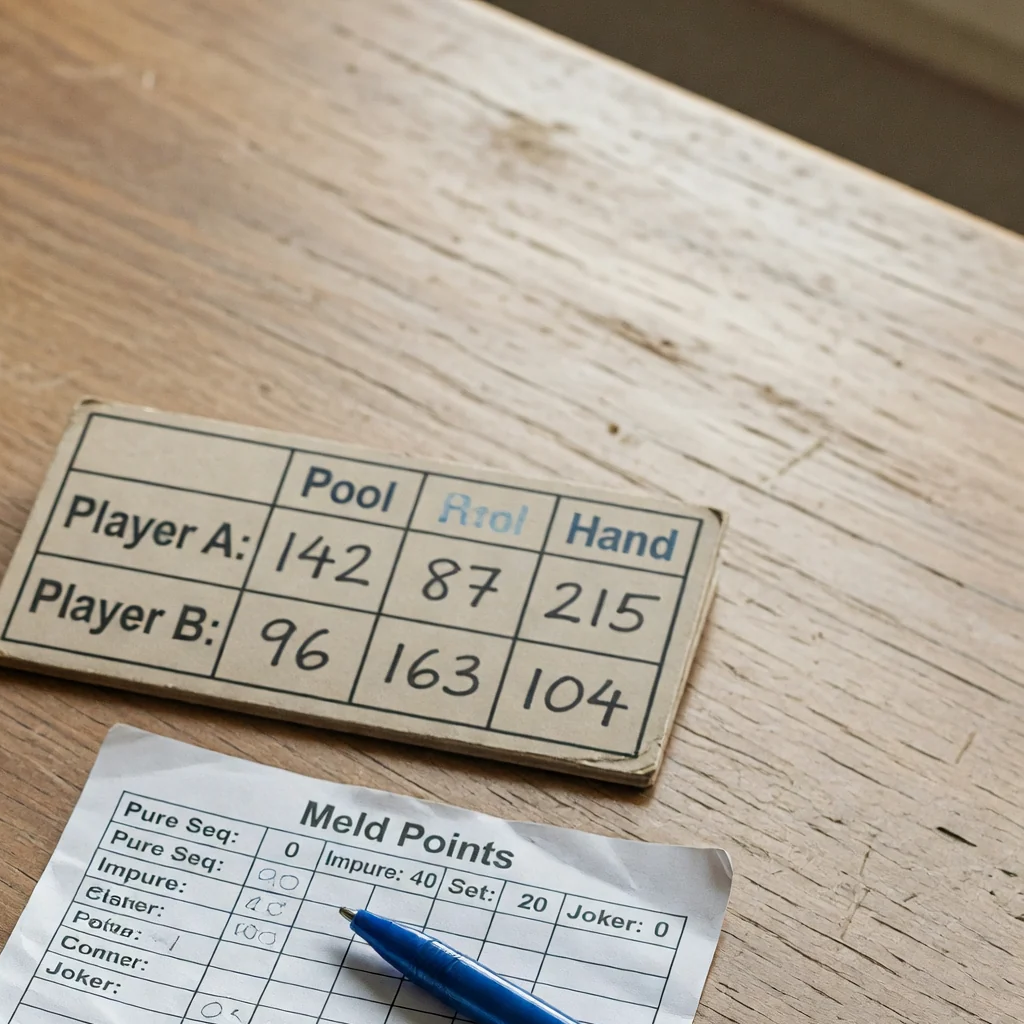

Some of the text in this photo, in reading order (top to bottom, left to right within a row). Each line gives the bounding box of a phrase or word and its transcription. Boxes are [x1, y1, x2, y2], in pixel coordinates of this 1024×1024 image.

[63, 495, 251, 562] Player A:
[301, 466, 397, 513] Pool
[566, 513, 678, 562] Hand
[29, 578, 221, 646] Player B:
[275, 532, 662, 633] 142 87 215
[261, 618, 628, 727] 96 163 104
[110, 830, 224, 873] Pure Seq:
[300, 800, 515, 869] Meld Points
[97, 857, 187, 894] Impure:
[124, 802, 670, 938] Pure Seq: 0 Impure: 40 Set: 20 Joker: 0
[45, 961, 121, 994] Joker:
